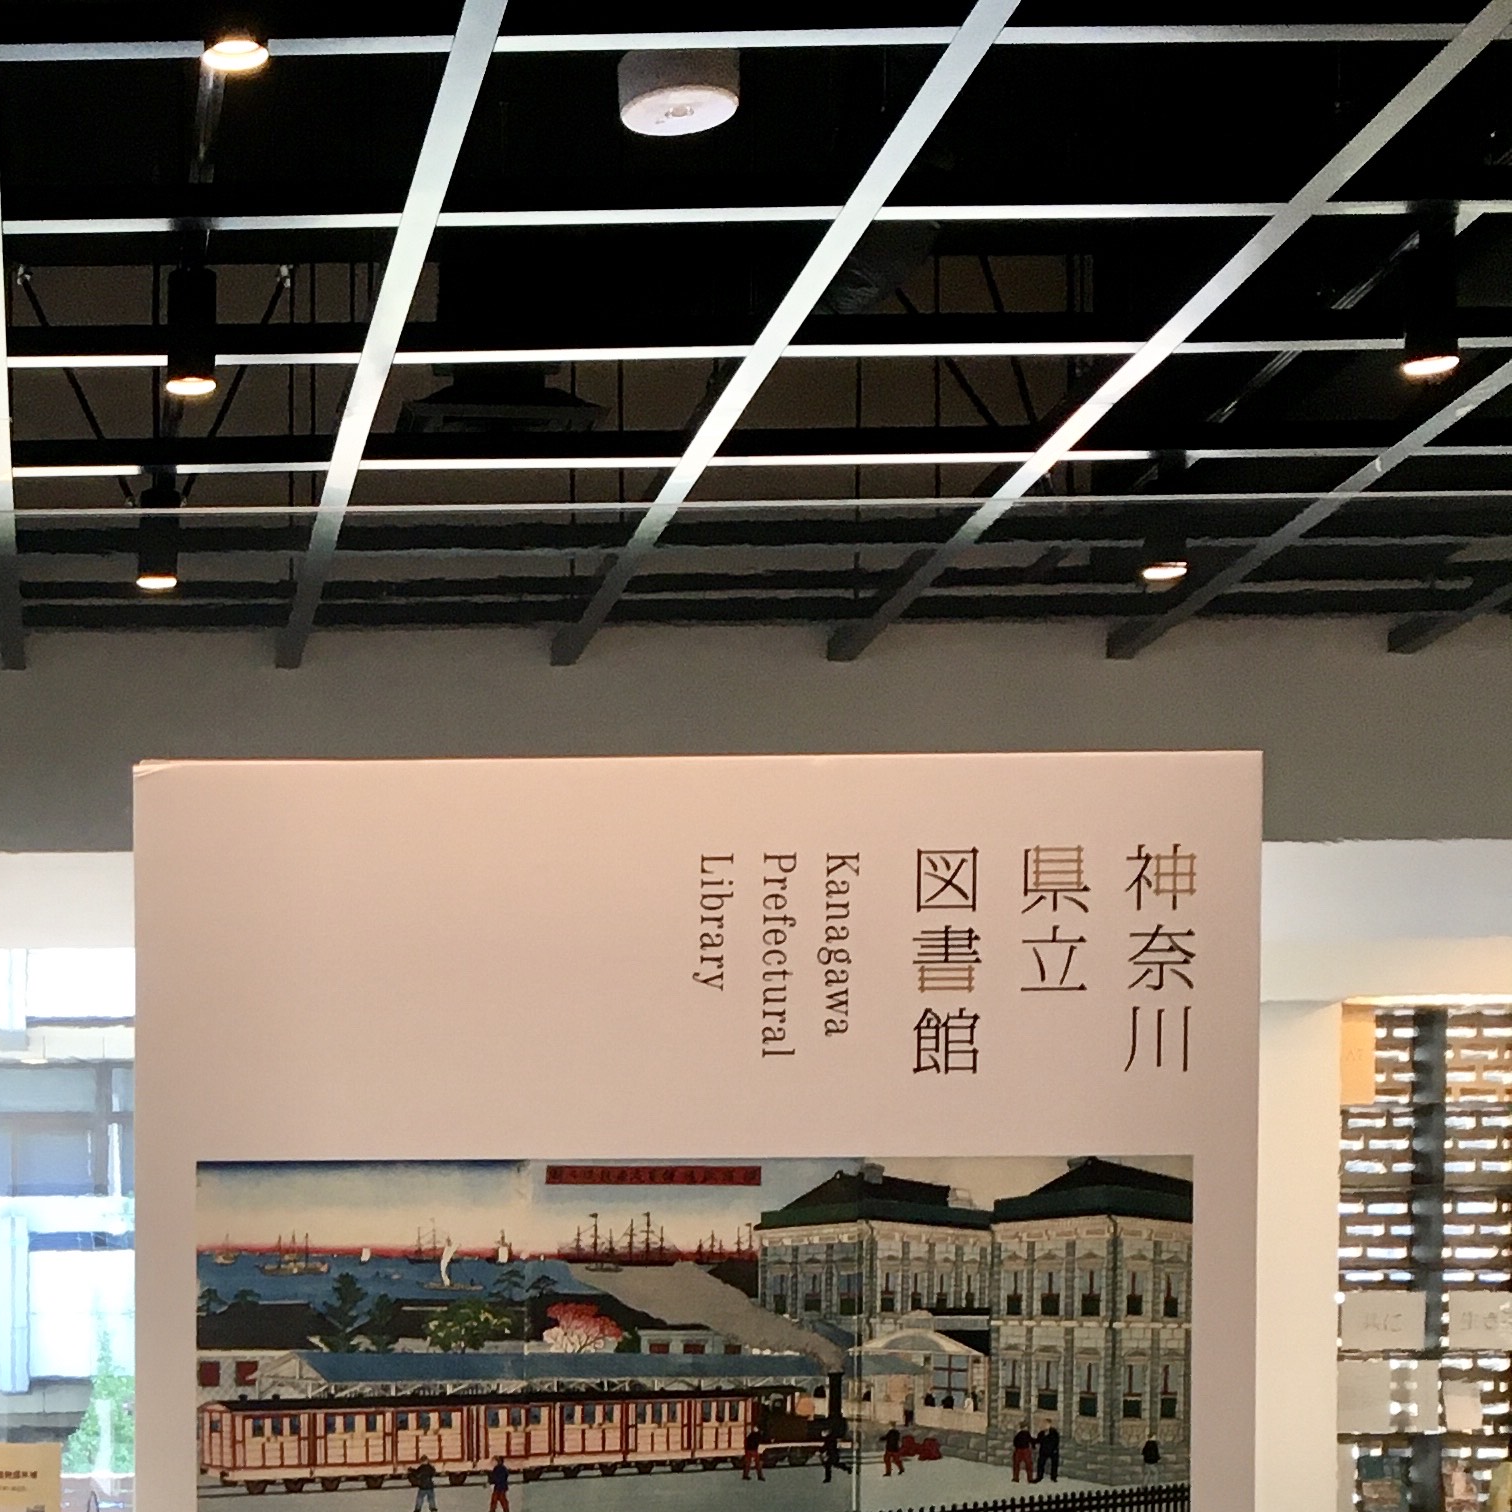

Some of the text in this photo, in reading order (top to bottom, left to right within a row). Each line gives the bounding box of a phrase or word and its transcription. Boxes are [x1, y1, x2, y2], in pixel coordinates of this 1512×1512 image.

[692, 853, 735, 993] Library
[761, 852, 798, 1059] Prefectural
[815, 852, 861, 1038] Kanagawa
[912, 846, 984, 1076] 図書館
[1020, 845, 1091, 993] 県立
[1124, 843, 1198, 1074] 神奈川
